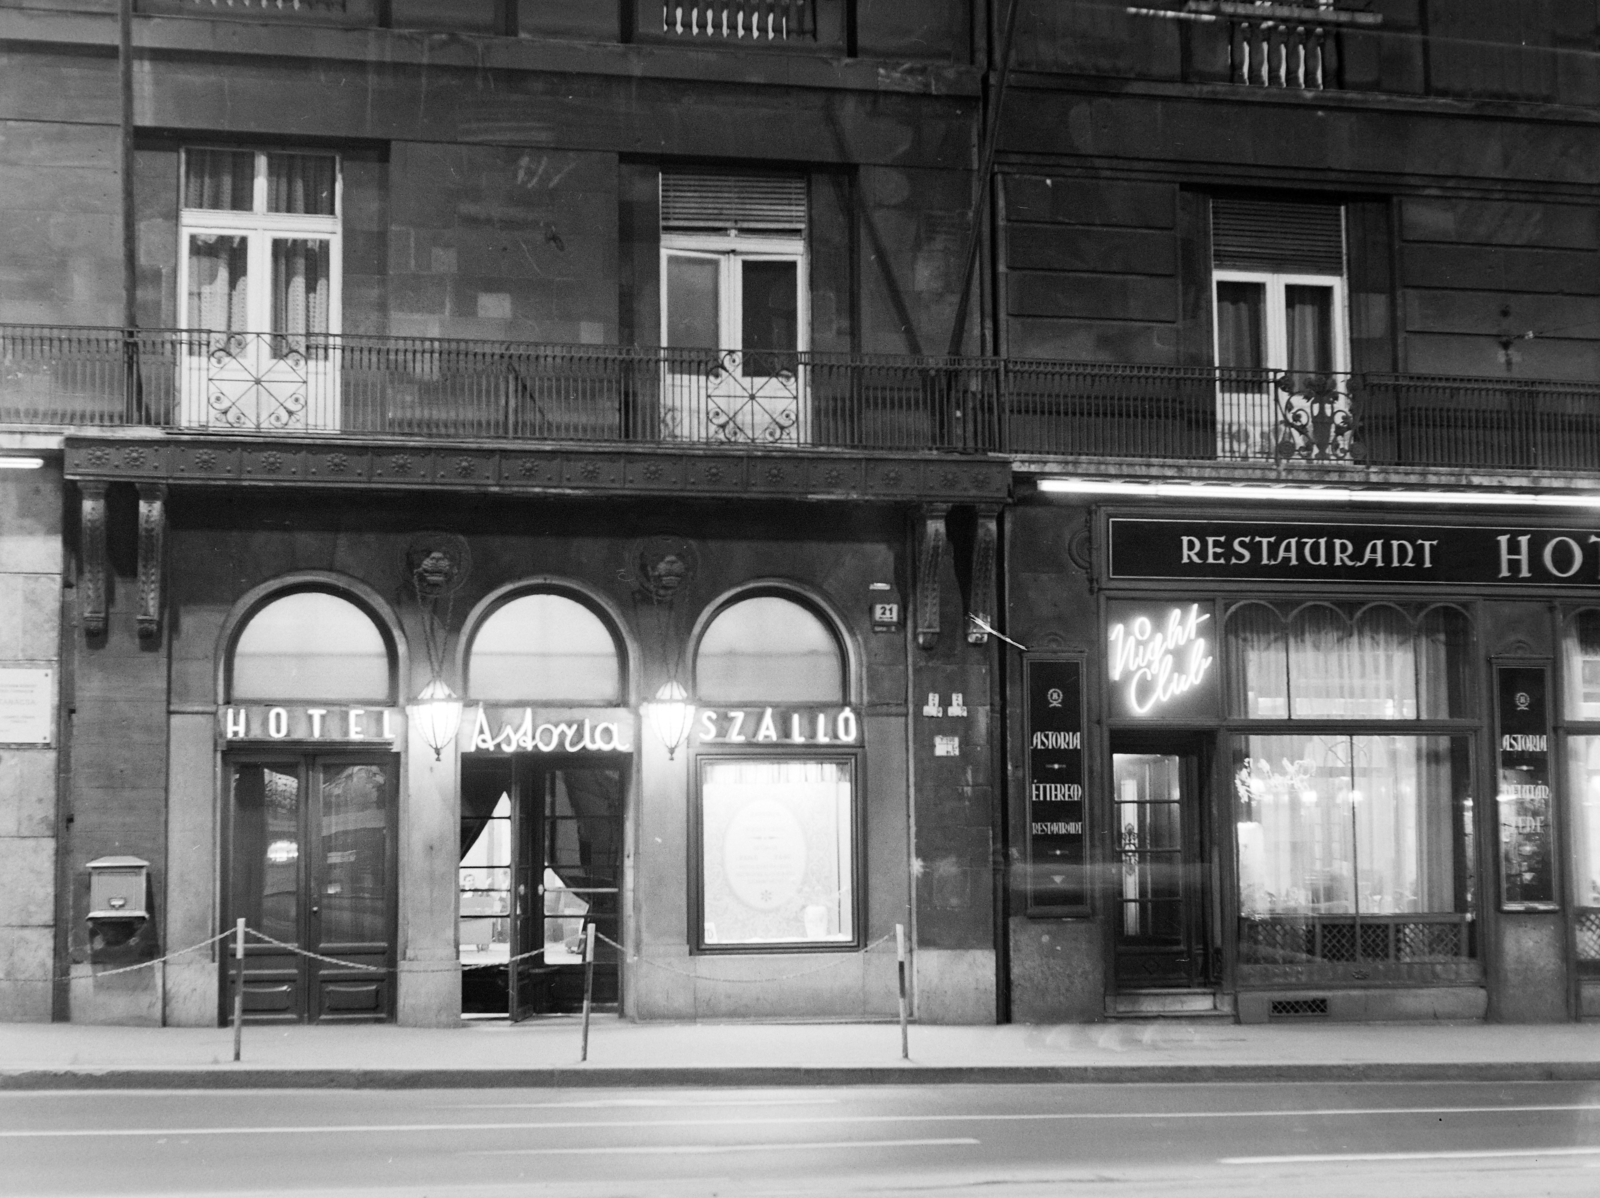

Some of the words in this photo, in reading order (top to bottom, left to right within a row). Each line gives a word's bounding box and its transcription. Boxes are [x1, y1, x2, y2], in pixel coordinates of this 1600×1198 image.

[1180, 534, 1439, 569] RESTAURANT
[880, 605, 893, 616] 21
[1110, 603, 1213, 680] Night
[1130, 637, 1214, 715] Club
[226, 708, 396, 739] HOTEL
[471, 703, 632, 754] Astoria
[698, 706, 860, 743] SZÁLLÓ
[1030, 731, 1081, 750] ASTORIA
[1500, 734, 1547, 752] ASTORIA
[1032, 779, 1082, 801] ÉTTEREM
[1032, 821, 1082, 835] RESTAURANT
